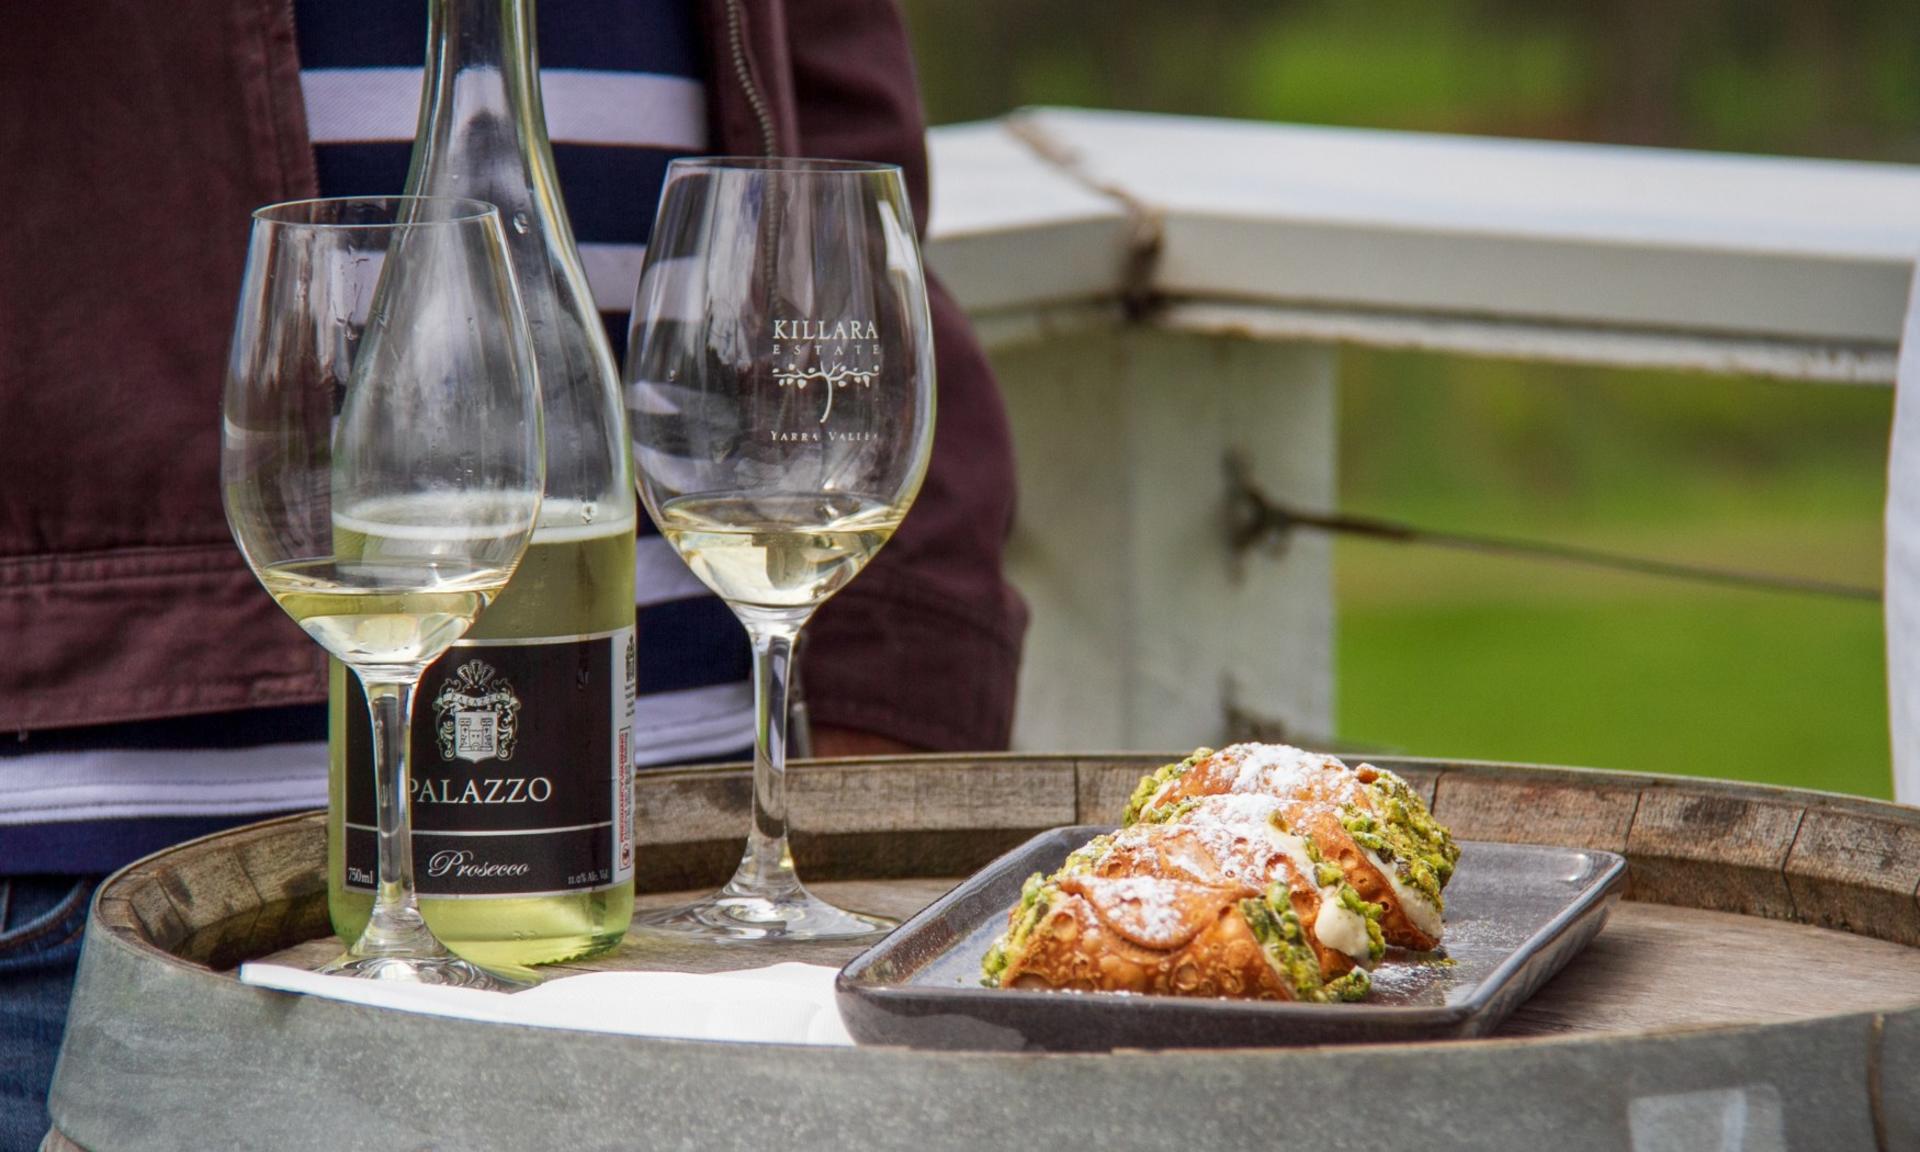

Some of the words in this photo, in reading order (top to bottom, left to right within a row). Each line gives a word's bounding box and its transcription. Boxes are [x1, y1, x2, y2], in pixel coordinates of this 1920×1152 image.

[773, 319, 879, 340] KILLARA
[772, 343, 881, 356] ESTATE
[770, 430, 819, 441] YARRA
[409, 776, 553, 804] PALAZZO
[427, 849, 530, 877] Prosecco
[348, 866, 374, 884] 750ml
